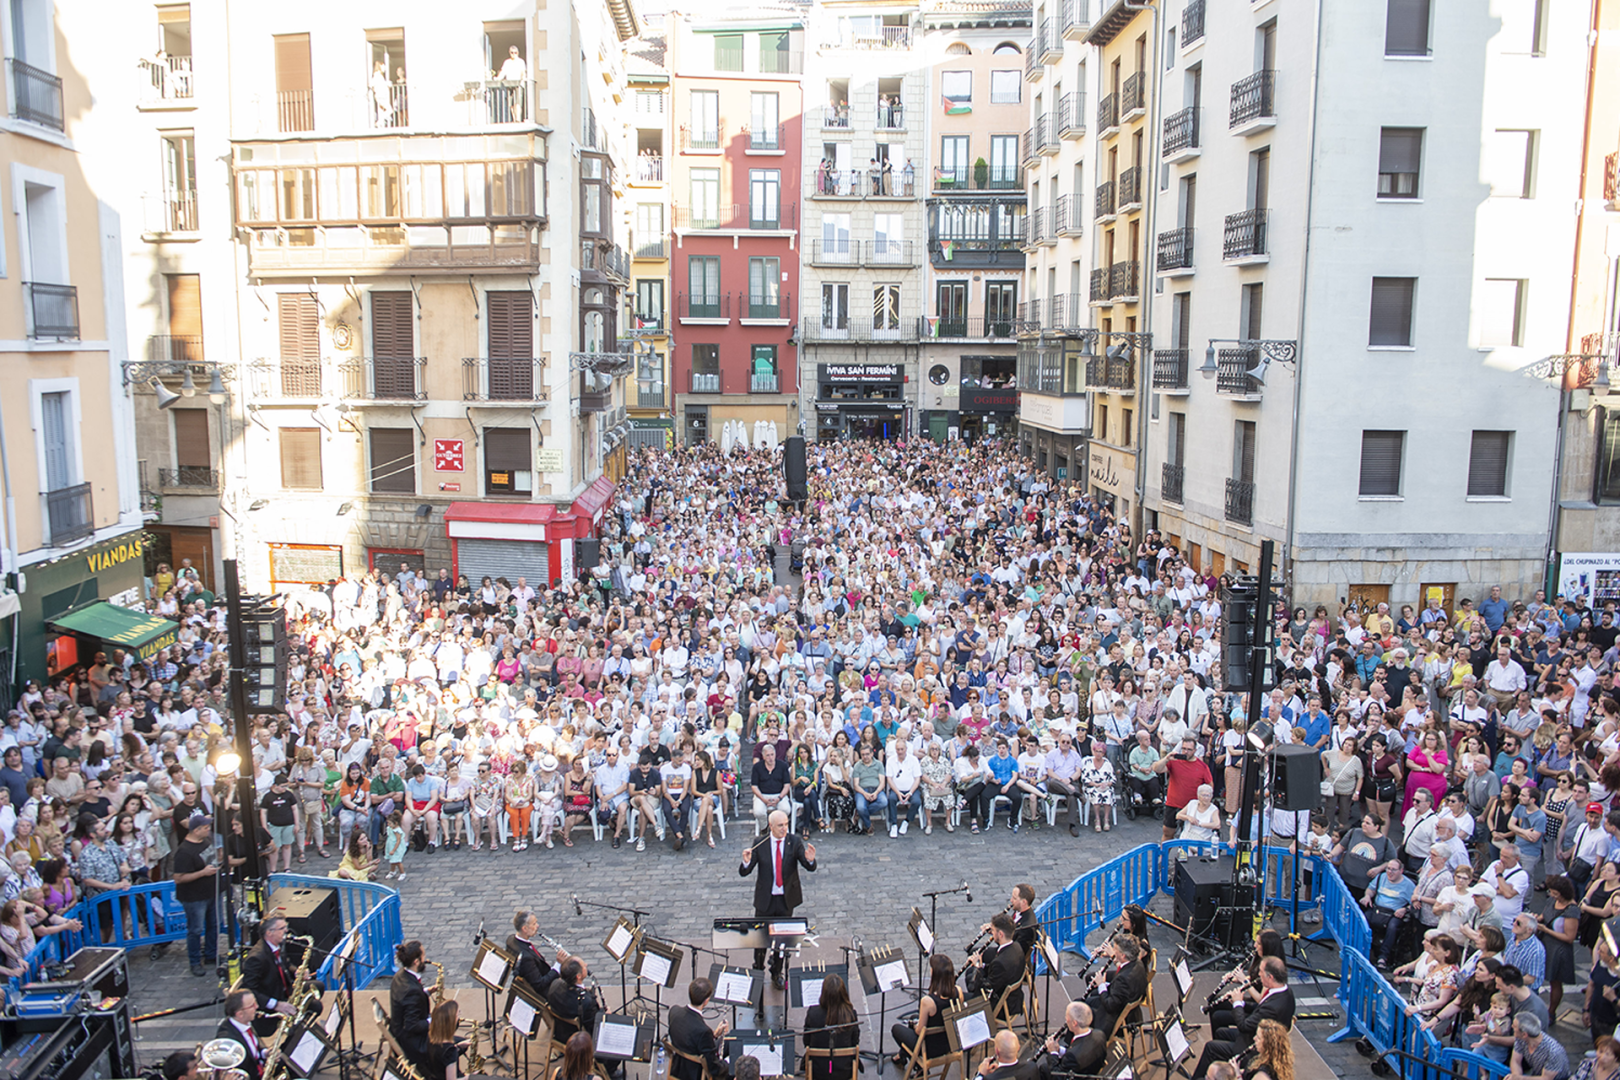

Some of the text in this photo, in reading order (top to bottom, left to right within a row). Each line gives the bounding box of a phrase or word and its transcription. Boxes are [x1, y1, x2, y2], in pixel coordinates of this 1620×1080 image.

[848, 366, 865, 375] SAN
[936, 397, 943, 406] 2
[1091, 456, 1119, 486] nails
[86, 540, 143, 573] VIANDAS
[108, 617, 168, 643] VIANDAS
[139, 632, 176, 659] VIANDAS
